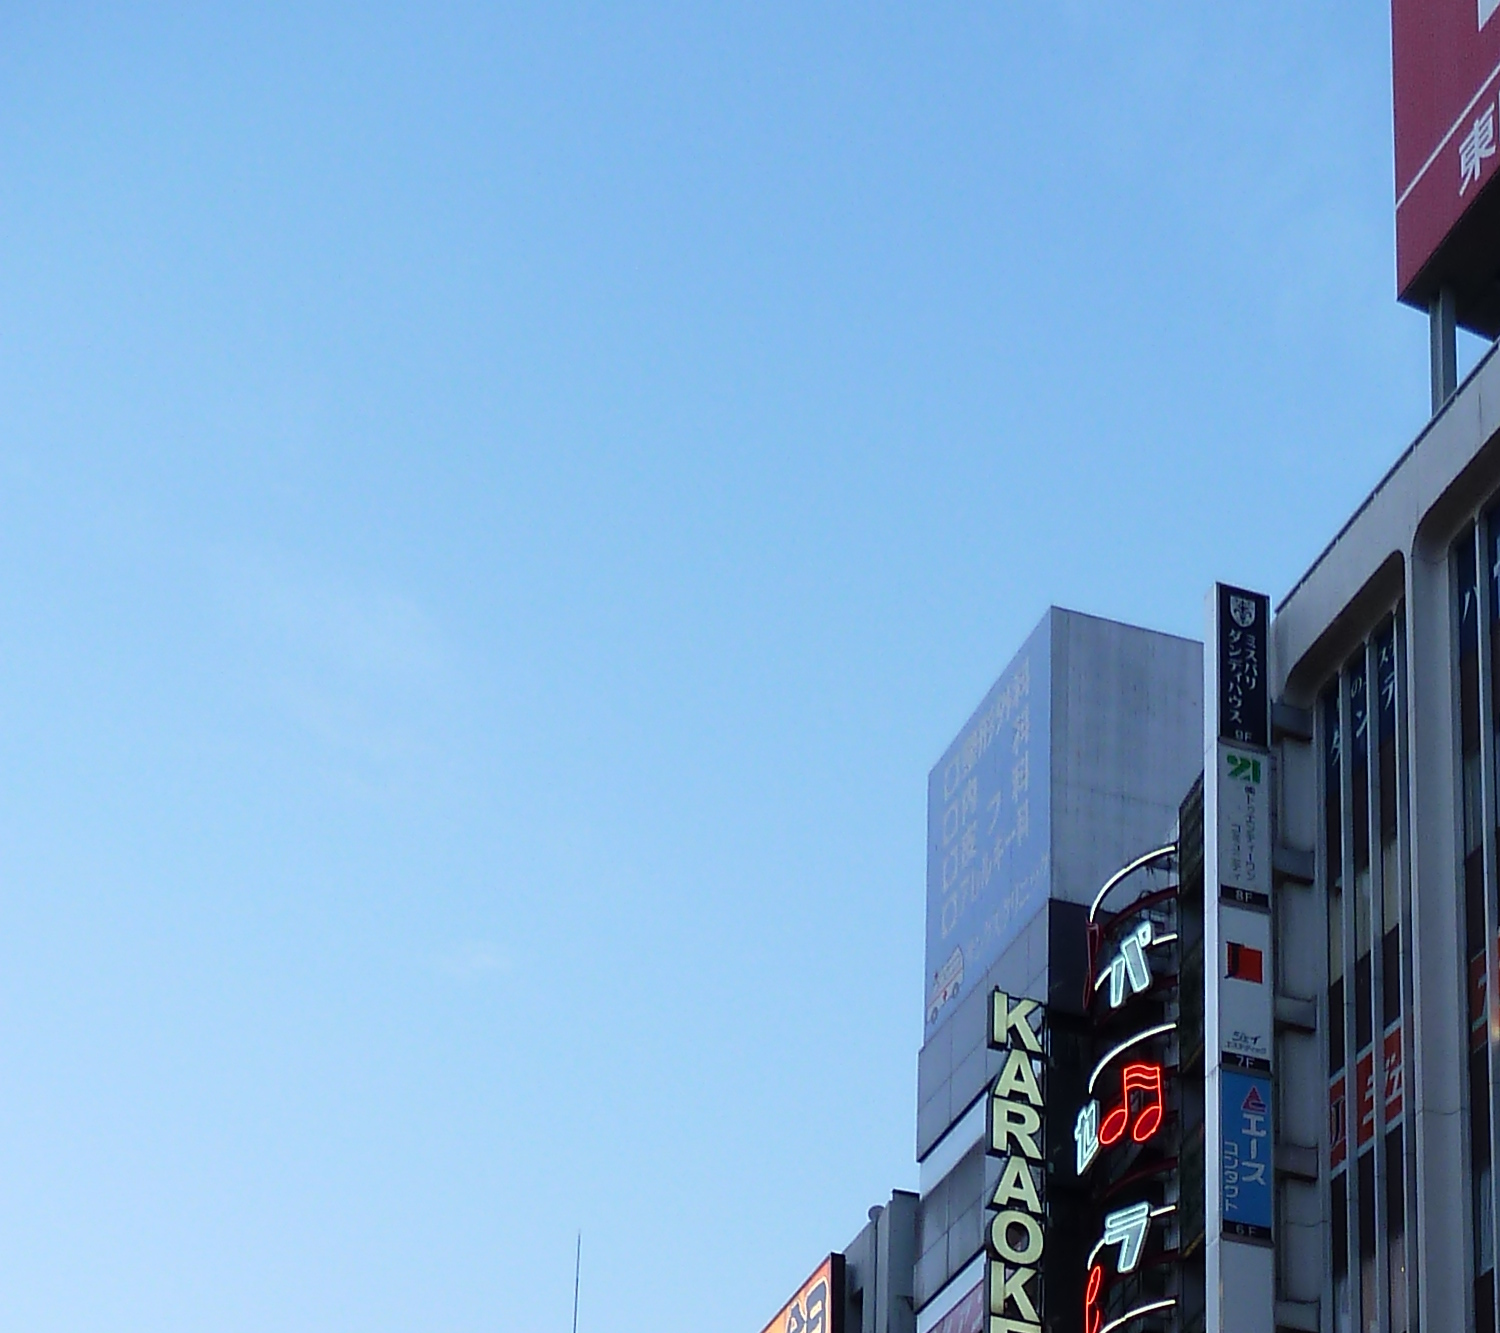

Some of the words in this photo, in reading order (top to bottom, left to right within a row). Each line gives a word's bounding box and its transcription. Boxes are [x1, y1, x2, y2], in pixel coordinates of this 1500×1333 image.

[1228, 627, 1243, 724] ダンディハウス
[1244, 632, 1258, 691] ミスパリ
[1235, 890, 1253, 902] 8F
[1236, 1055, 1255, 1068] 7F
[1224, 1141, 1239, 1212] コンタクト
[1241, 1113, 1267, 1186] エース
[1236, 1225, 1257, 1237] 6F
